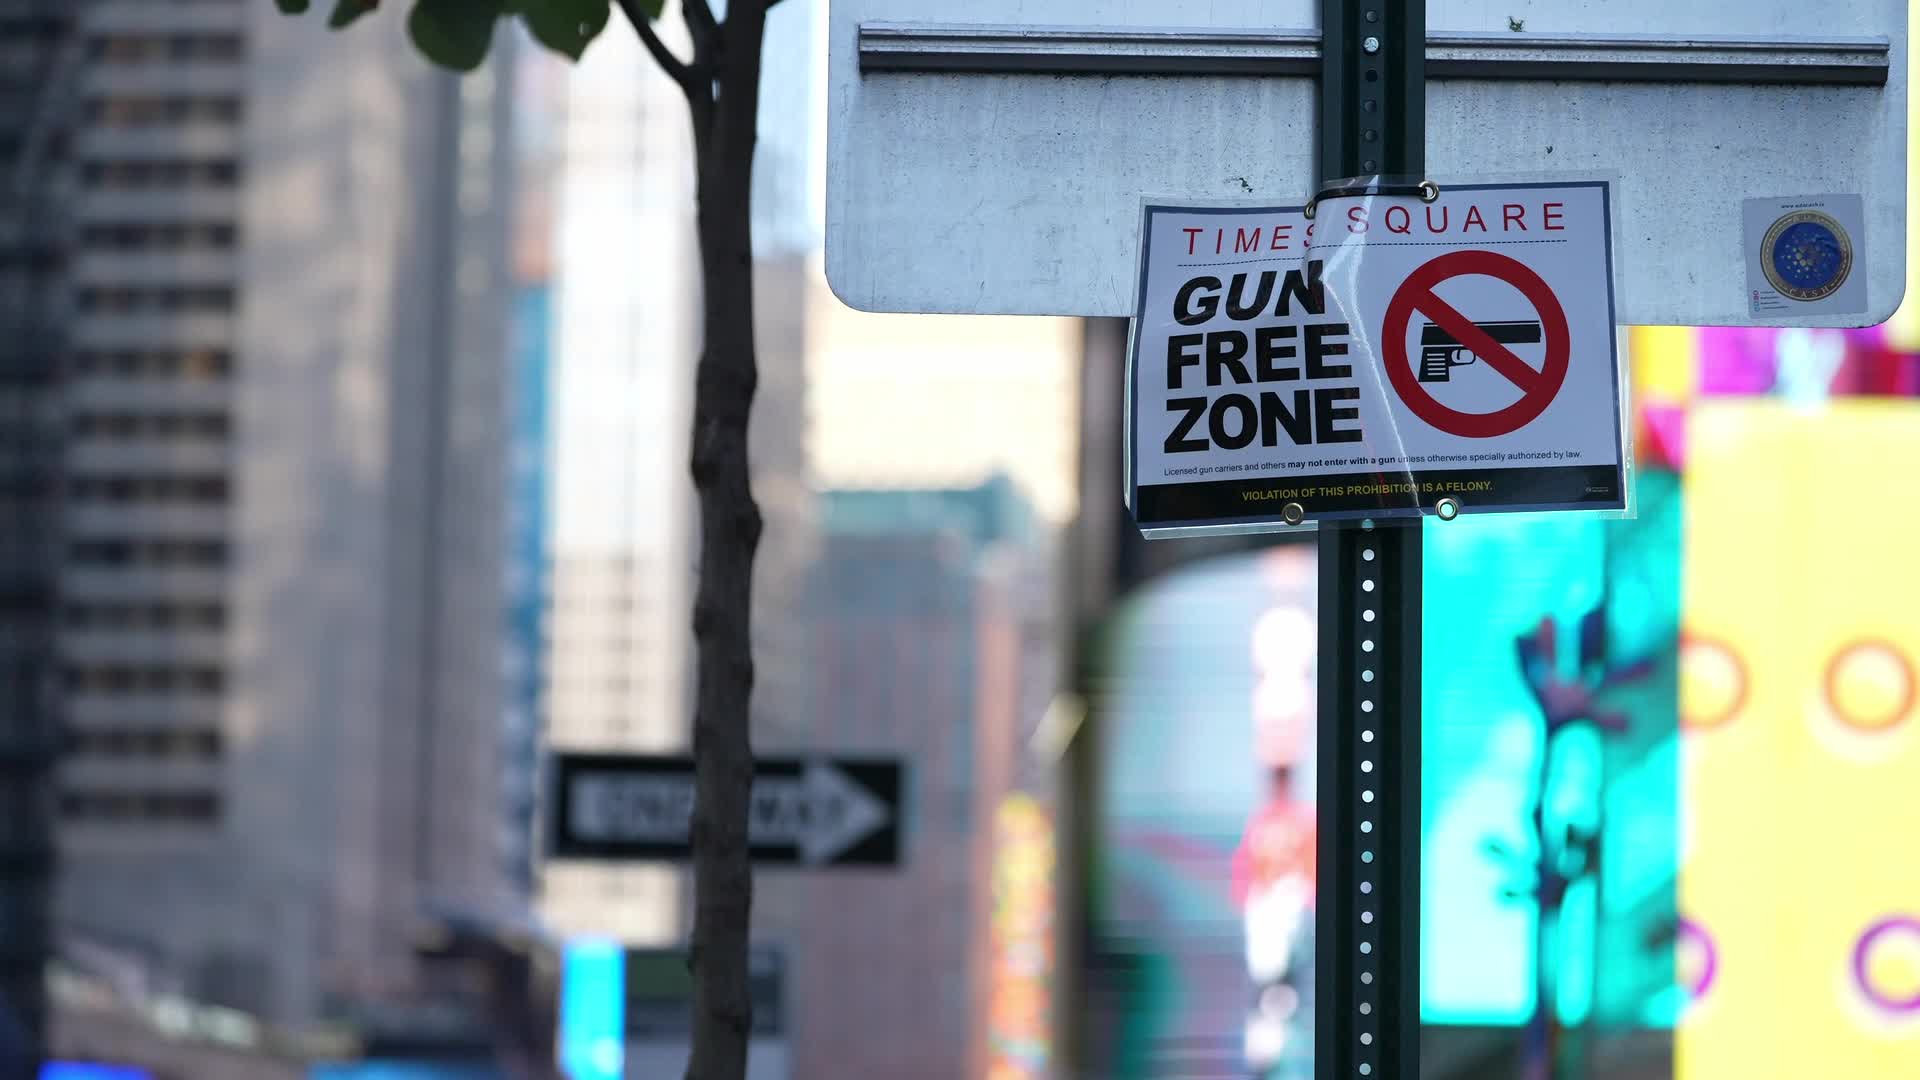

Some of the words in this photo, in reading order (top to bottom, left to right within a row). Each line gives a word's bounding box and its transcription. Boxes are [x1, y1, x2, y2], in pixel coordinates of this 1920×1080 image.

[1346, 202, 1566, 235] SQUARE
[1173, 259, 1326, 326] GUN
[1788, 286, 1830, 299] CASH
[1167, 323, 1353, 390] FREE
[1164, 387, 1363, 454] ZONE
[1164, 468, 1198, 477] Licensed
[1199, 467, 1213, 476] gun
[1214, 464, 1243, 473] carriers
[1244, 463, 1259, 471] and
[1260, 461, 1287, 470] others
[1287, 459, 1306, 469] may
[1307, 459, 1323, 467] not
[1324, 458, 1348, 466] enter
[1349, 457, 1369, 465] with
[1378, 457, 1396, 466] gun
[1397, 454, 1425, 463] unless
[1427, 453, 1468, 462] otherwise
[1469, 452, 1506, 462] specially
[1507, 450, 1552, 461] authorized
[1553, 450, 1564, 460] by
[1565, 450, 1583, 458] law.
[1242, 489, 1299, 501] VIOLATION
[1300, 487, 1317, 498] OF
[1318, 486, 1345, 497] THIS
[1347, 484, 1420, 496] PROHIBITION
[1422, 484, 1434, 493] IS
[1436, 483, 1445, 492] A
[1446, 481, 1494, 492] FELONY.
